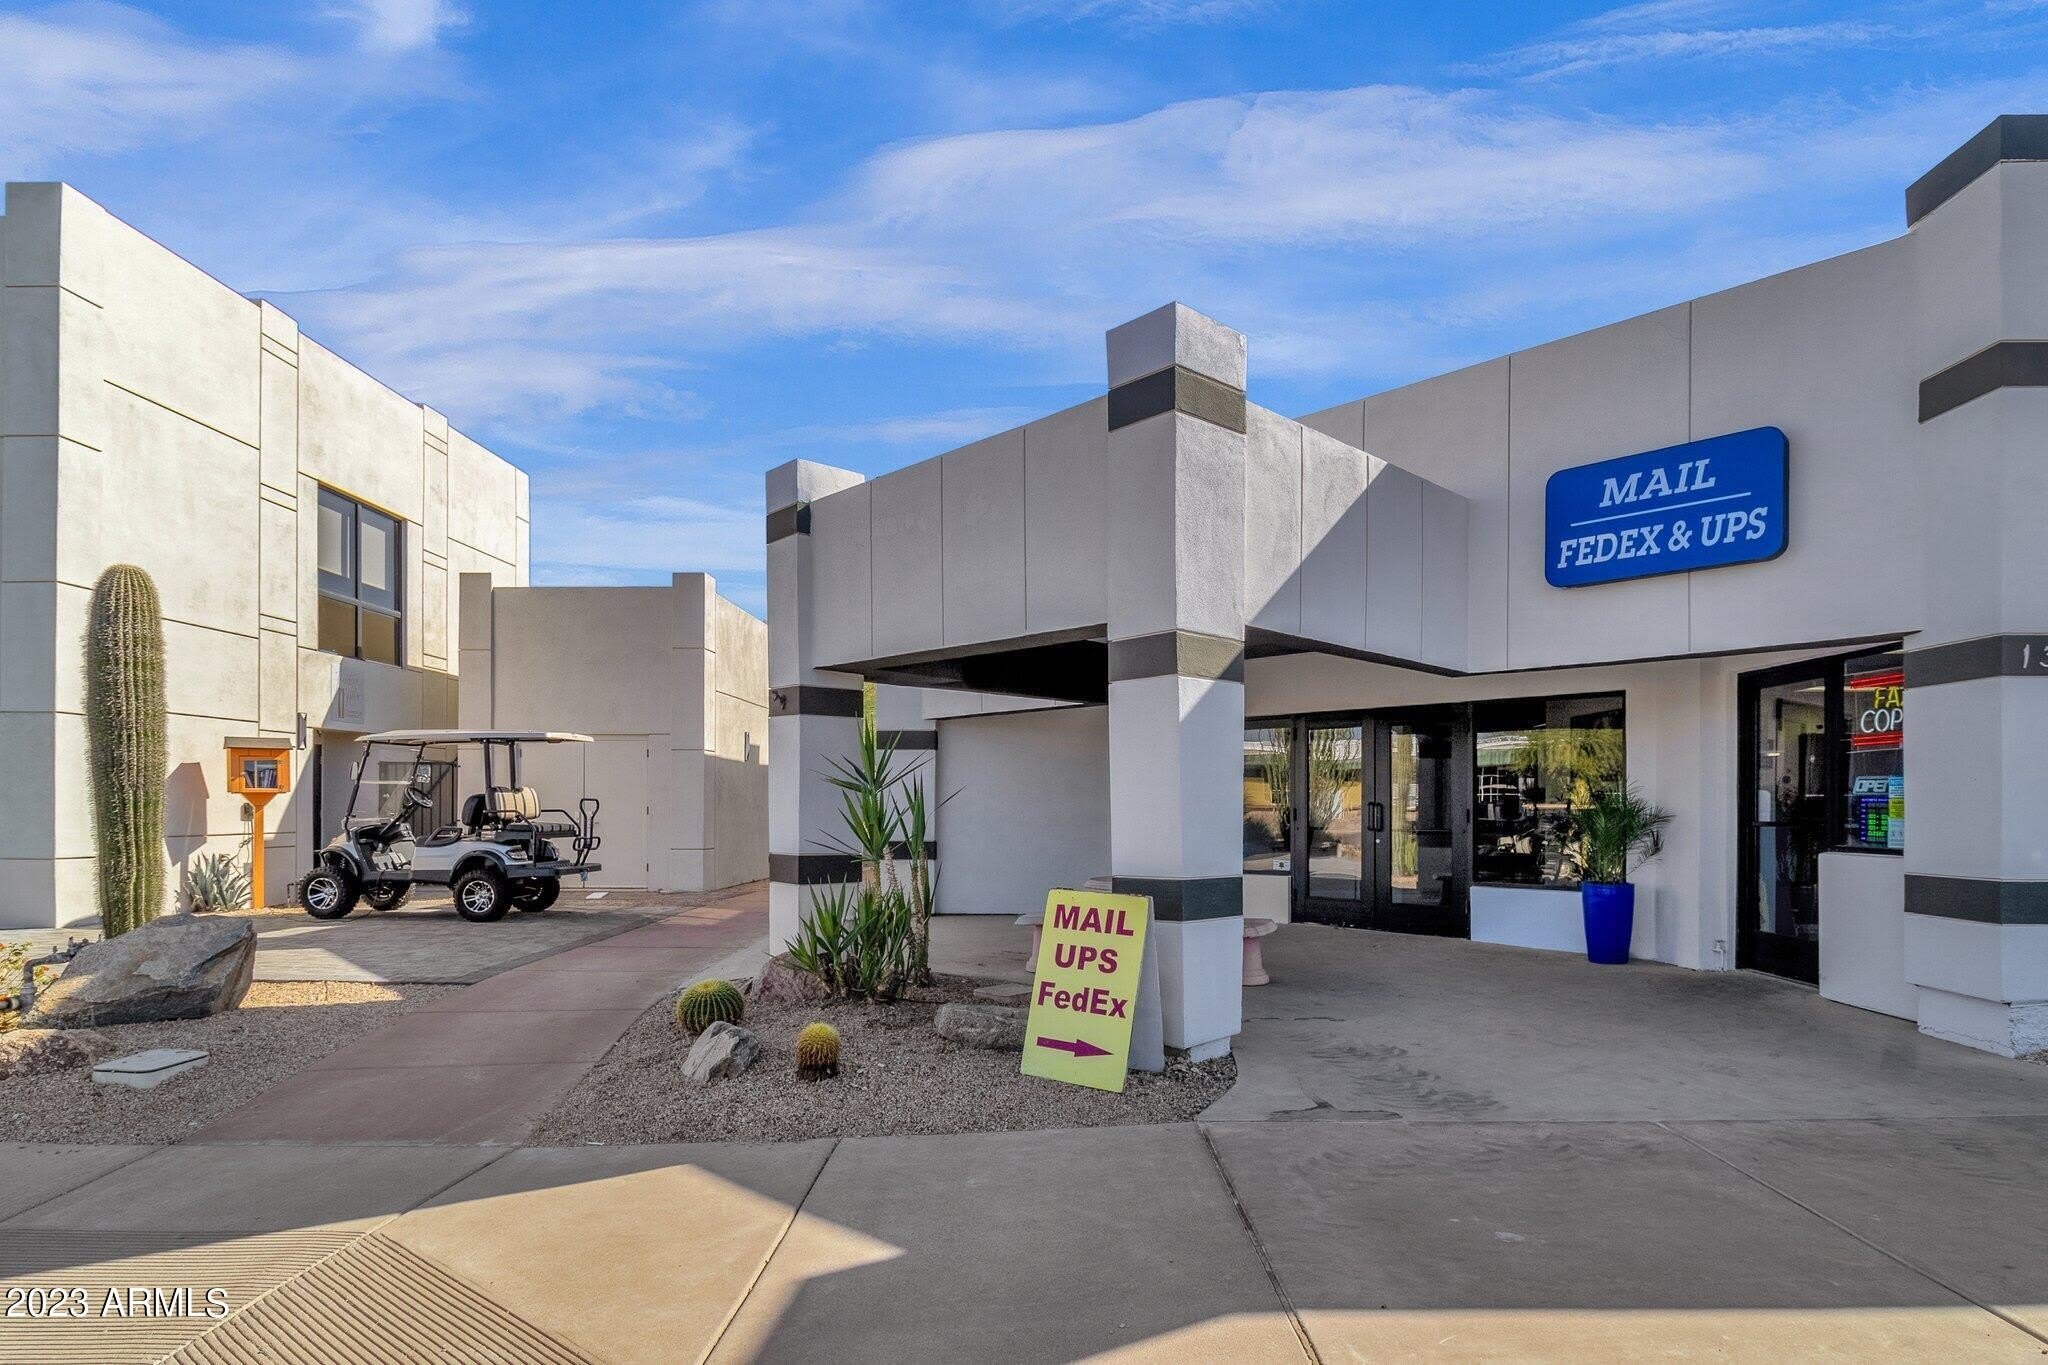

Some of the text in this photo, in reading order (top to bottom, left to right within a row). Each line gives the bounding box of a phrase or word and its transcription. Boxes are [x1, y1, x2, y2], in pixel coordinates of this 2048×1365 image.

[1599, 458, 1716, 508] MAIL
[1557, 506, 1768, 569] FEDEX & UPS
[1873, 686, 1903, 709] FA
[1860, 708, 1903, 733] COP
[1053, 903, 1134, 937] MAIL
[1054, 943, 1118, 974] UPS
[1037, 981, 1128, 1019] FedEx
